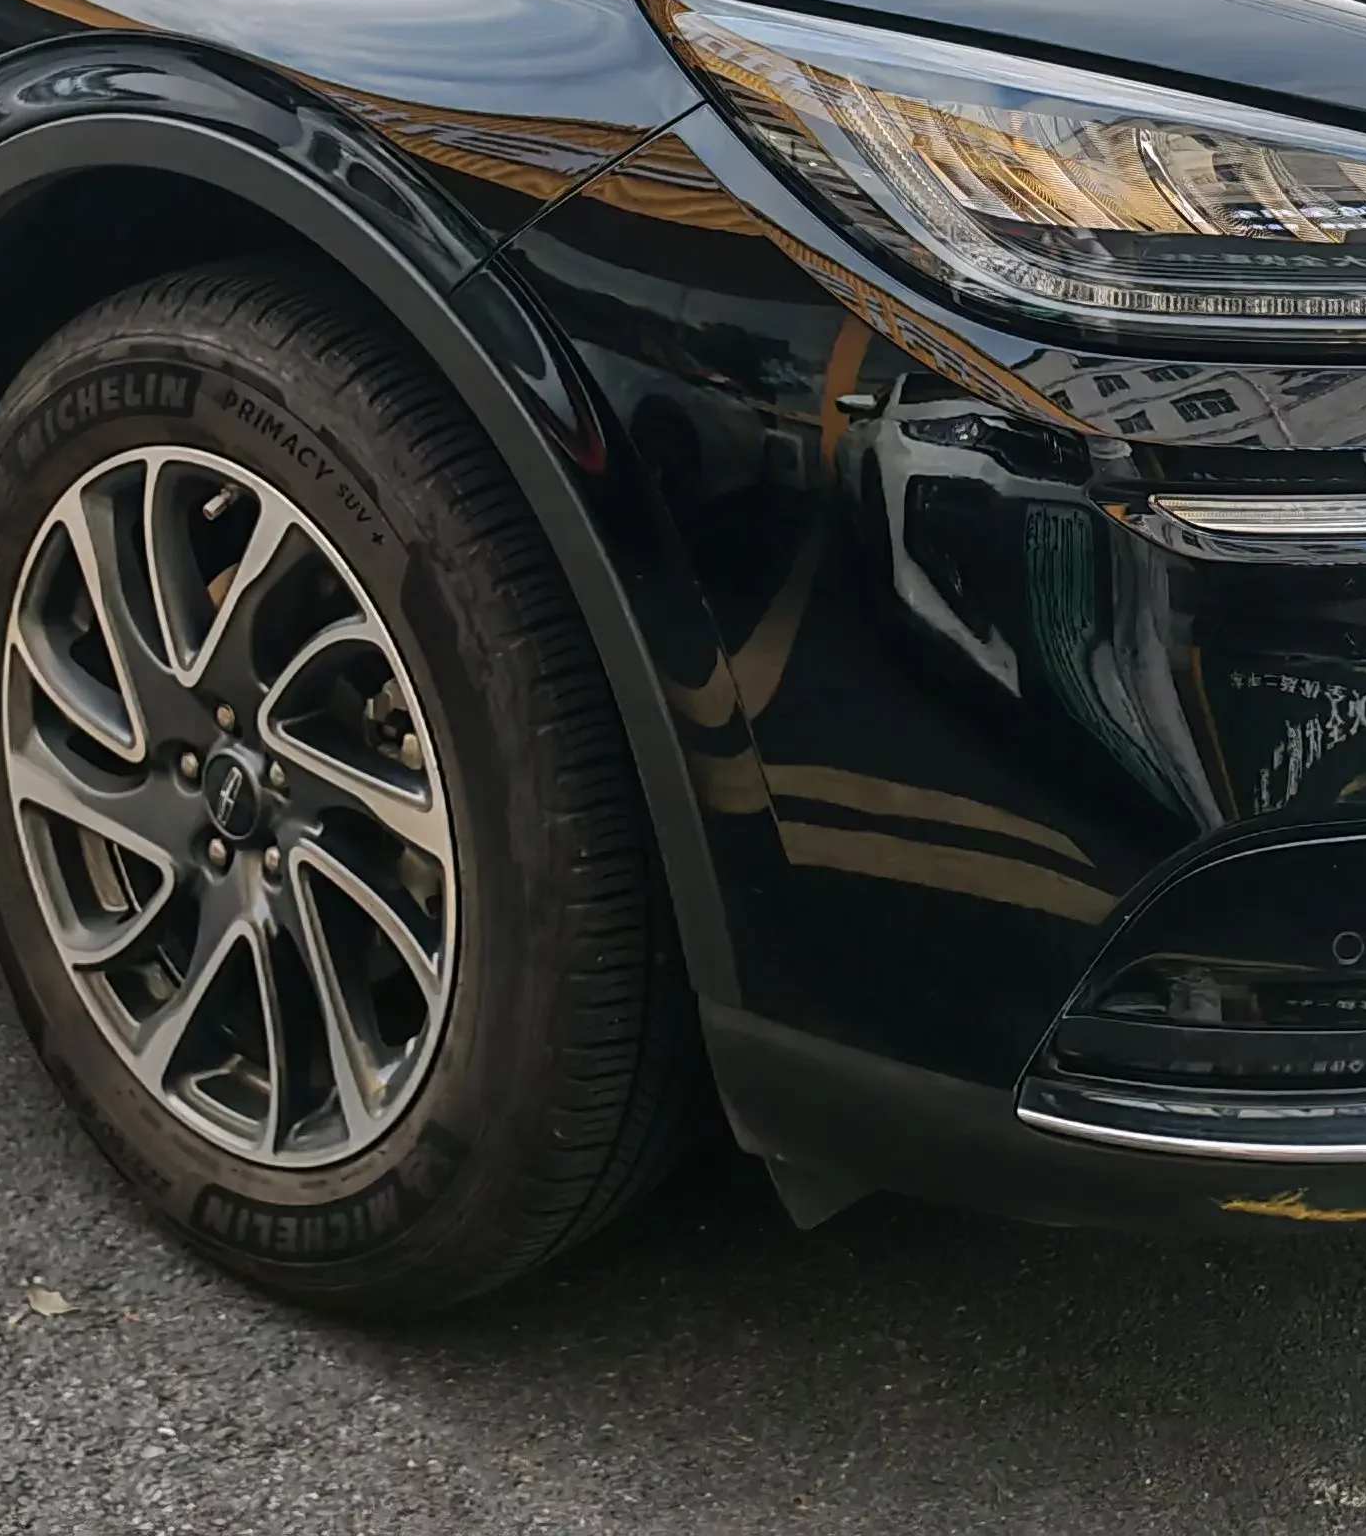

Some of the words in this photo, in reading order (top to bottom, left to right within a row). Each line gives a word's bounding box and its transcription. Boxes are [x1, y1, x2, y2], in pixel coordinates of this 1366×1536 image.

[17, 373, 190, 472] MICHELIN
[222, 388, 334, 481] PRIMACY
[336, 482, 373, 523] SUV
[202, 1184, 399, 1253] MICHELIN
